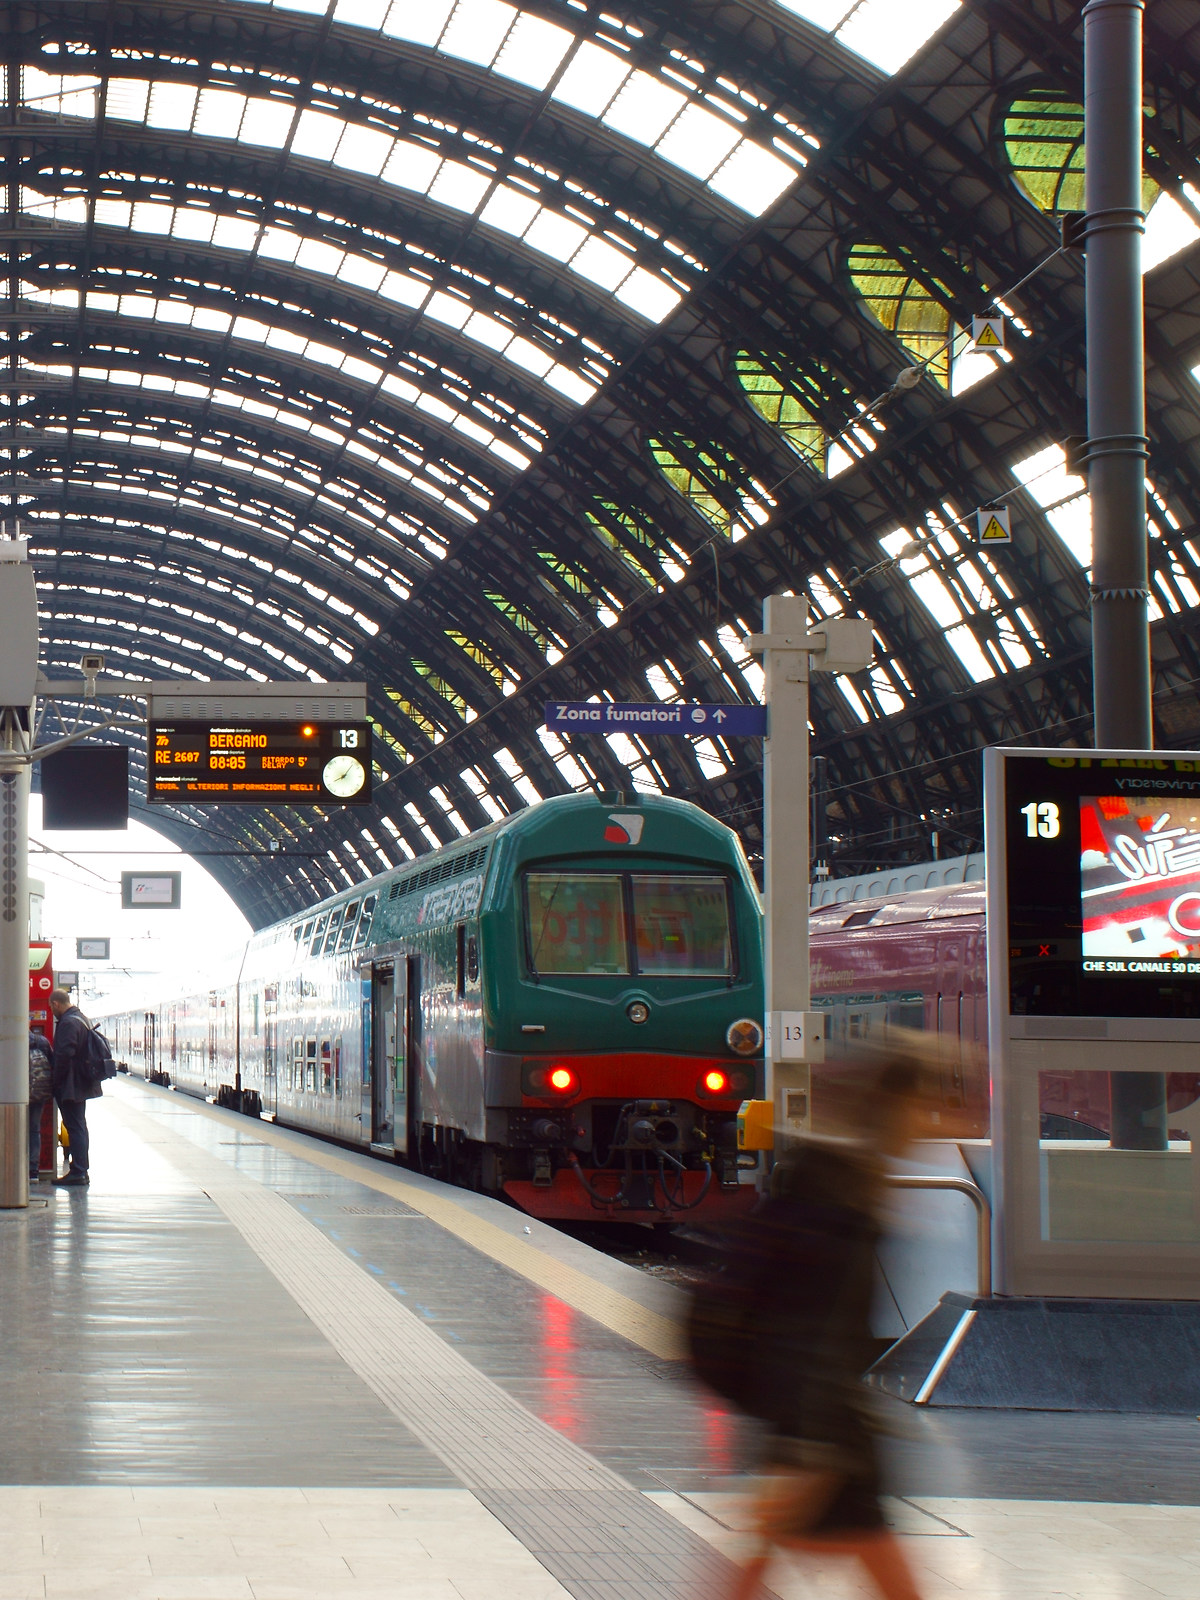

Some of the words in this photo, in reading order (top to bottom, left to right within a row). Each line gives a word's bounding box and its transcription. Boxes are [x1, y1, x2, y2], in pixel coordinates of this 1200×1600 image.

[555, 705, 601, 720] Zona
[606, 706, 681, 722] fumatori
[209, 734, 267, 748] BERGAMO
[339, 729, 358, 748] 13
[155, 750, 171, 764] RE
[174, 751, 200, 763] 2607
[209, 756, 246, 769] 08:05
[261, 756, 295, 764] RITARDO
[187, 783, 229, 791] ULTERIORI
[232, 783, 286, 791] INFORMAZIONI
[290, 783, 314, 791] NEGLI
[1020, 801, 1061, 839] 13
[1082, 961, 1106, 972] CHE
[1106, 961, 1127, 972] SUL
[1127, 962, 1170, 972] CANALE
[1171, 962, 1186, 973] 50
[784, 1026, 802, 1041] 13
